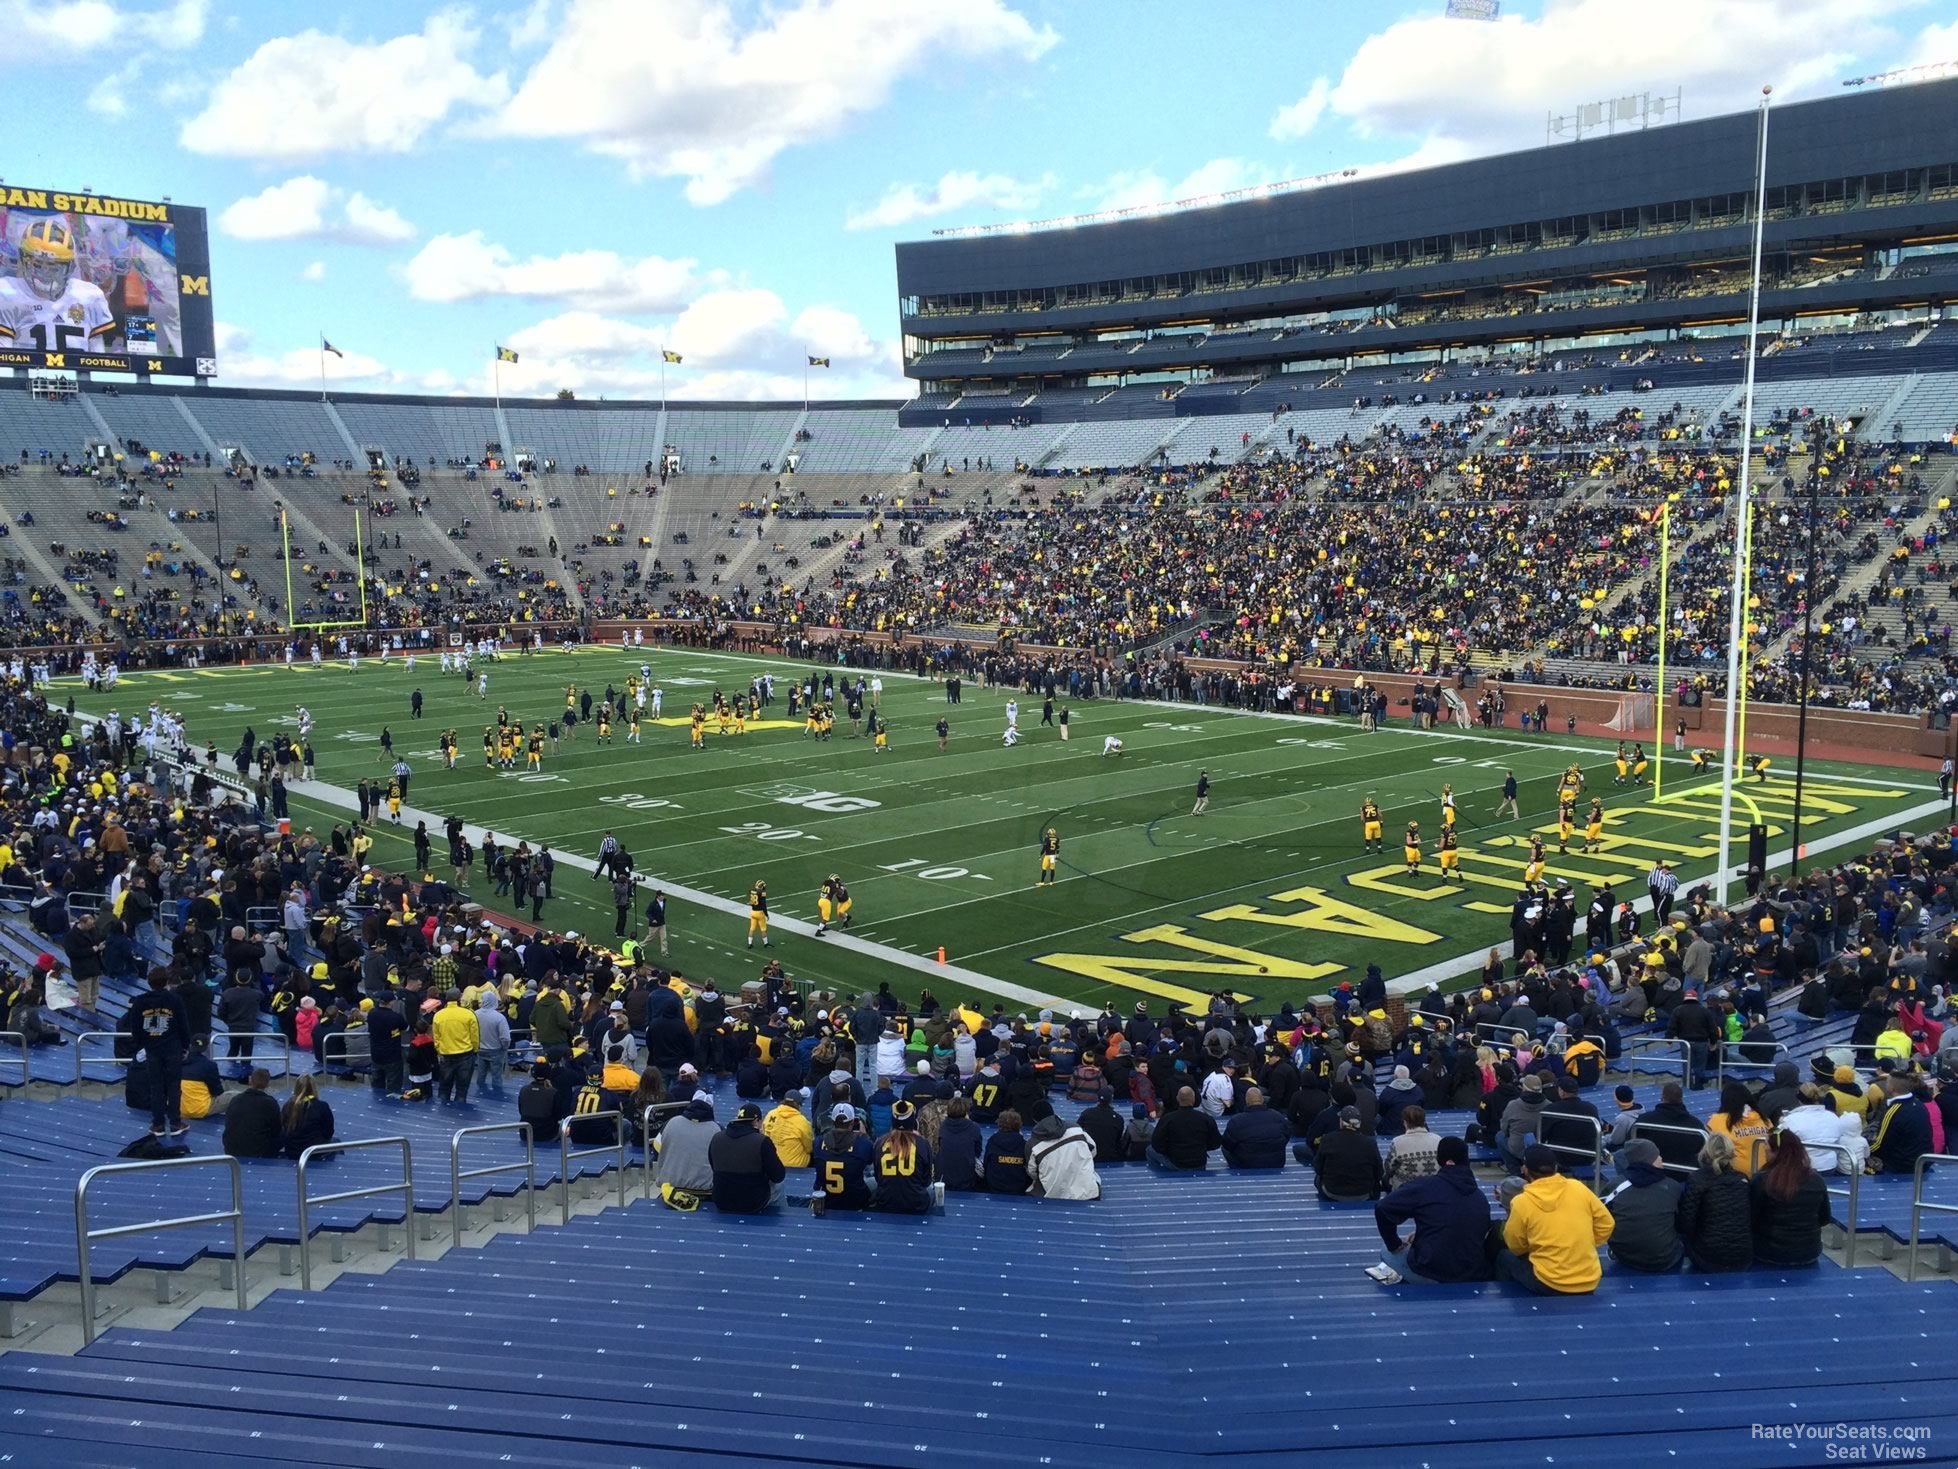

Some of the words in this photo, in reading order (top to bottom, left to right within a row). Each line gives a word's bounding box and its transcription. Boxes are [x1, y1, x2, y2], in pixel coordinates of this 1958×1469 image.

[53, 194, 168, 221] STADIUM
[181, 275, 209, 296] M
[30, 324, 85, 351] 15
[45, 353, 65, 367] M
[80, 357, 127, 368] FOOTBALL
[148, 360, 162, 371] M
[199, 359, 216, 374] 25
[599, 793, 670, 808] 30
[1365, 806, 1377, 817] 75
[718, 822, 804, 841] 20
[1050, 840, 1057, 850] 5
[876, 858, 969, 880] 10
[1825, 907, 1832, 921] 2
[575, 1092, 601, 1115] 10
[973, 1084, 998, 1108] 47
[881, 1142, 917, 1177] 20
[825, 1160, 844, 1194] 5
